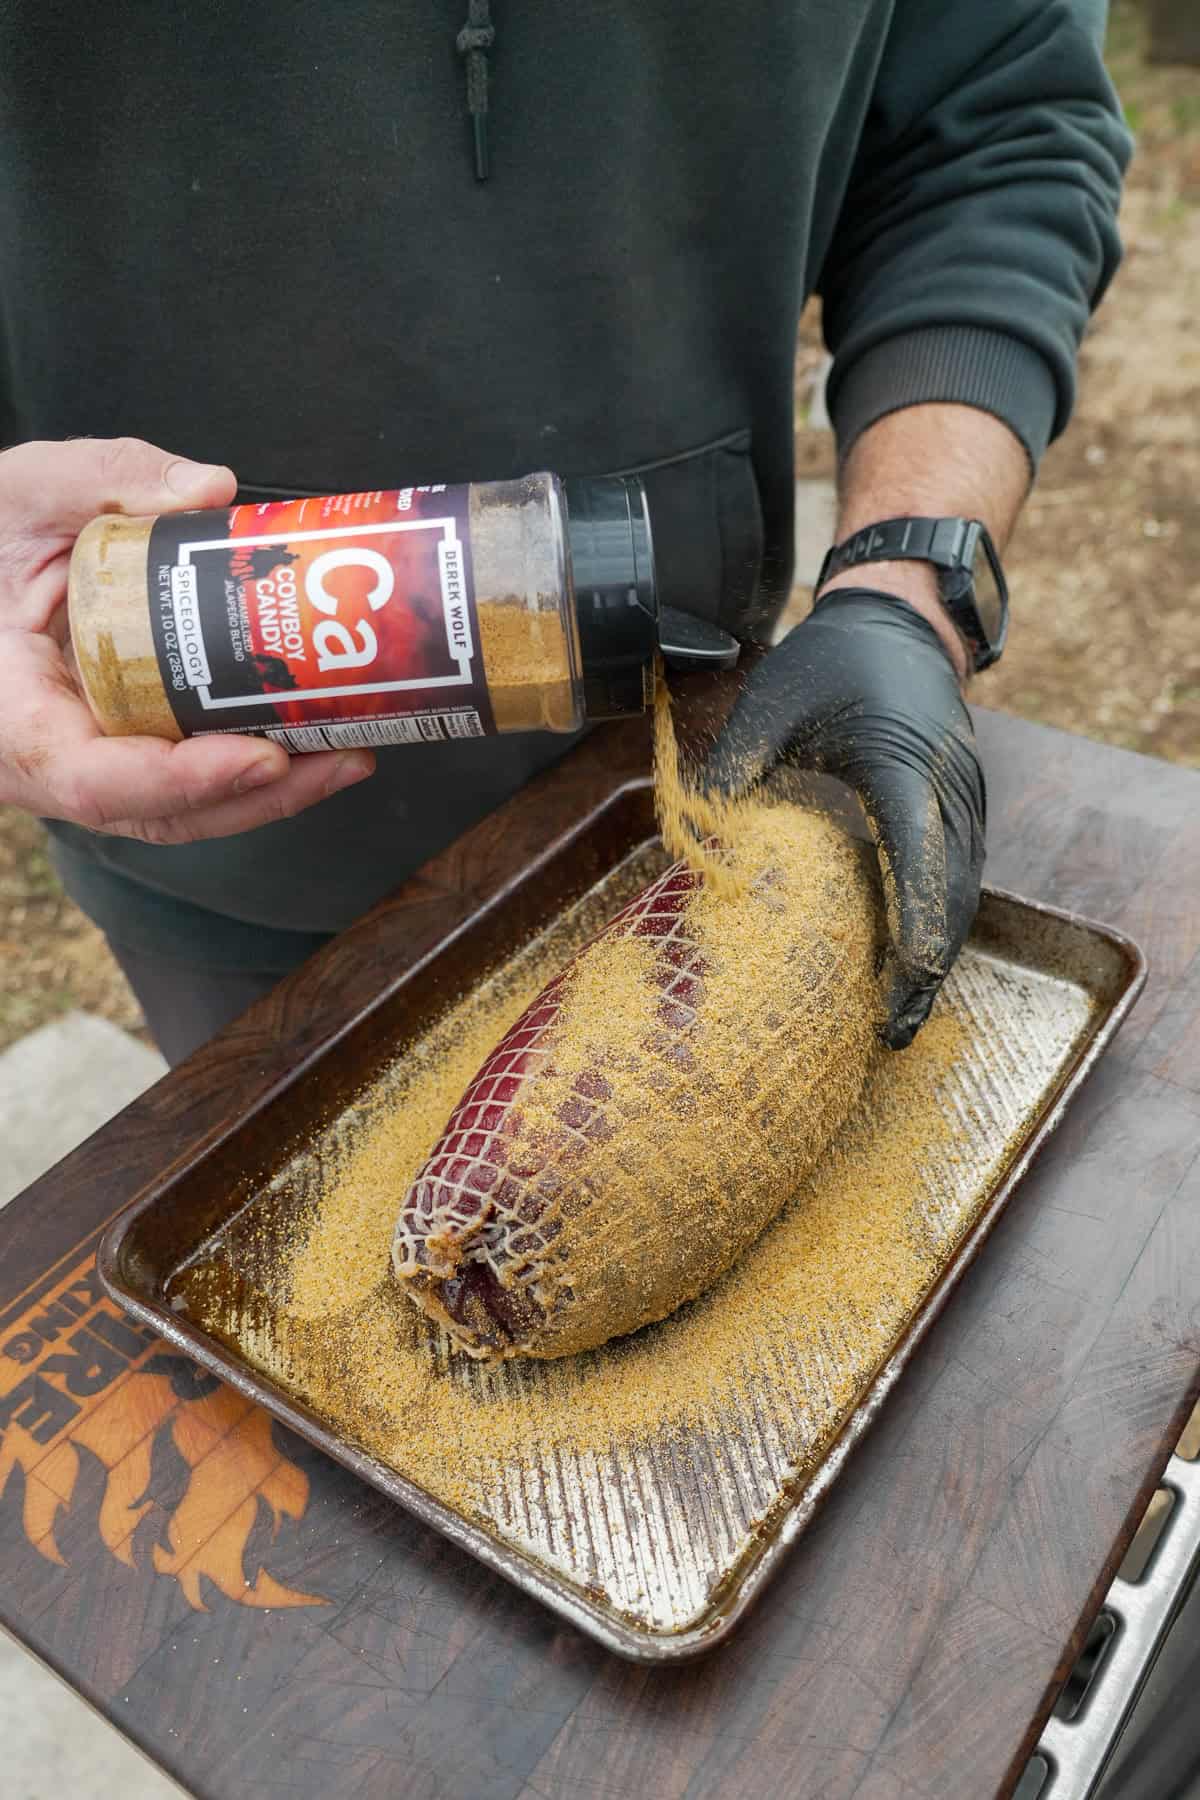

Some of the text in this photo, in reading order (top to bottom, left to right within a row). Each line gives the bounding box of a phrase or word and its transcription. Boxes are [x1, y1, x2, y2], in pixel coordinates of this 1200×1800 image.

[159, 565, 187, 691] NET WT. 10 OZ (283g)
[178, 570, 205, 679] SPICEOLOGY
[230, 629, 245, 662] BLEND
[236, 585, 254, 653] CARAMELIZED
[255, 578, 282, 656] CANDY
[275, 567, 306, 662] COWBOY
[305, 547, 395, 673] Ca
[445, 551, 467, 649] DEREK WOLF
